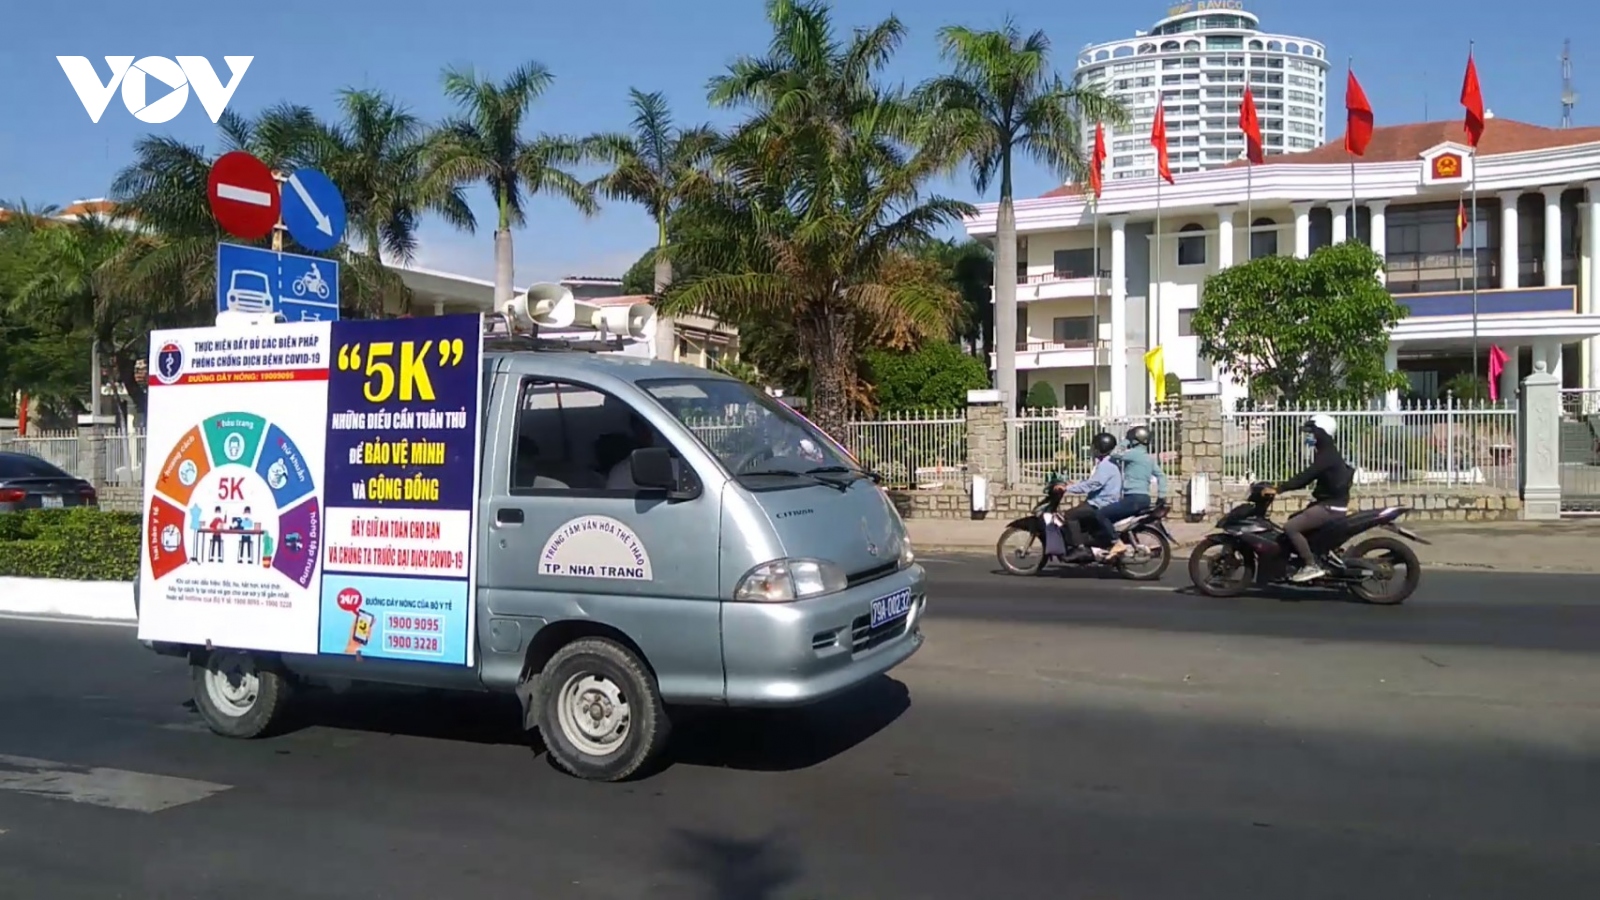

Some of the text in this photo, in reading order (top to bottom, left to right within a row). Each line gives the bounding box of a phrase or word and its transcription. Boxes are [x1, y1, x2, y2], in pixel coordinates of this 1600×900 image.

[298, 333, 319, 348] PHÁP
[285, 352, 321, 365] COVID-19
[364, 435, 390, 465] BẢO
[392, 437, 408, 469] VỆ
[411, 437, 445, 465] MÌNH
[218, 477, 245, 500] 5K
[352, 479, 366, 500] VÀ
[368, 473, 402, 504] CỘNG
[409, 520, 425, 539] CHO
[545, 534, 565, 560] TRUNG
[363, 547, 372, 565] TA
[429, 550, 464, 569] COVID-19
[544, 563, 644, 578] TP. NHA TRANG
[388, 616, 439, 631] 1900 9095
[388, 635, 438, 651] 1900 3228
